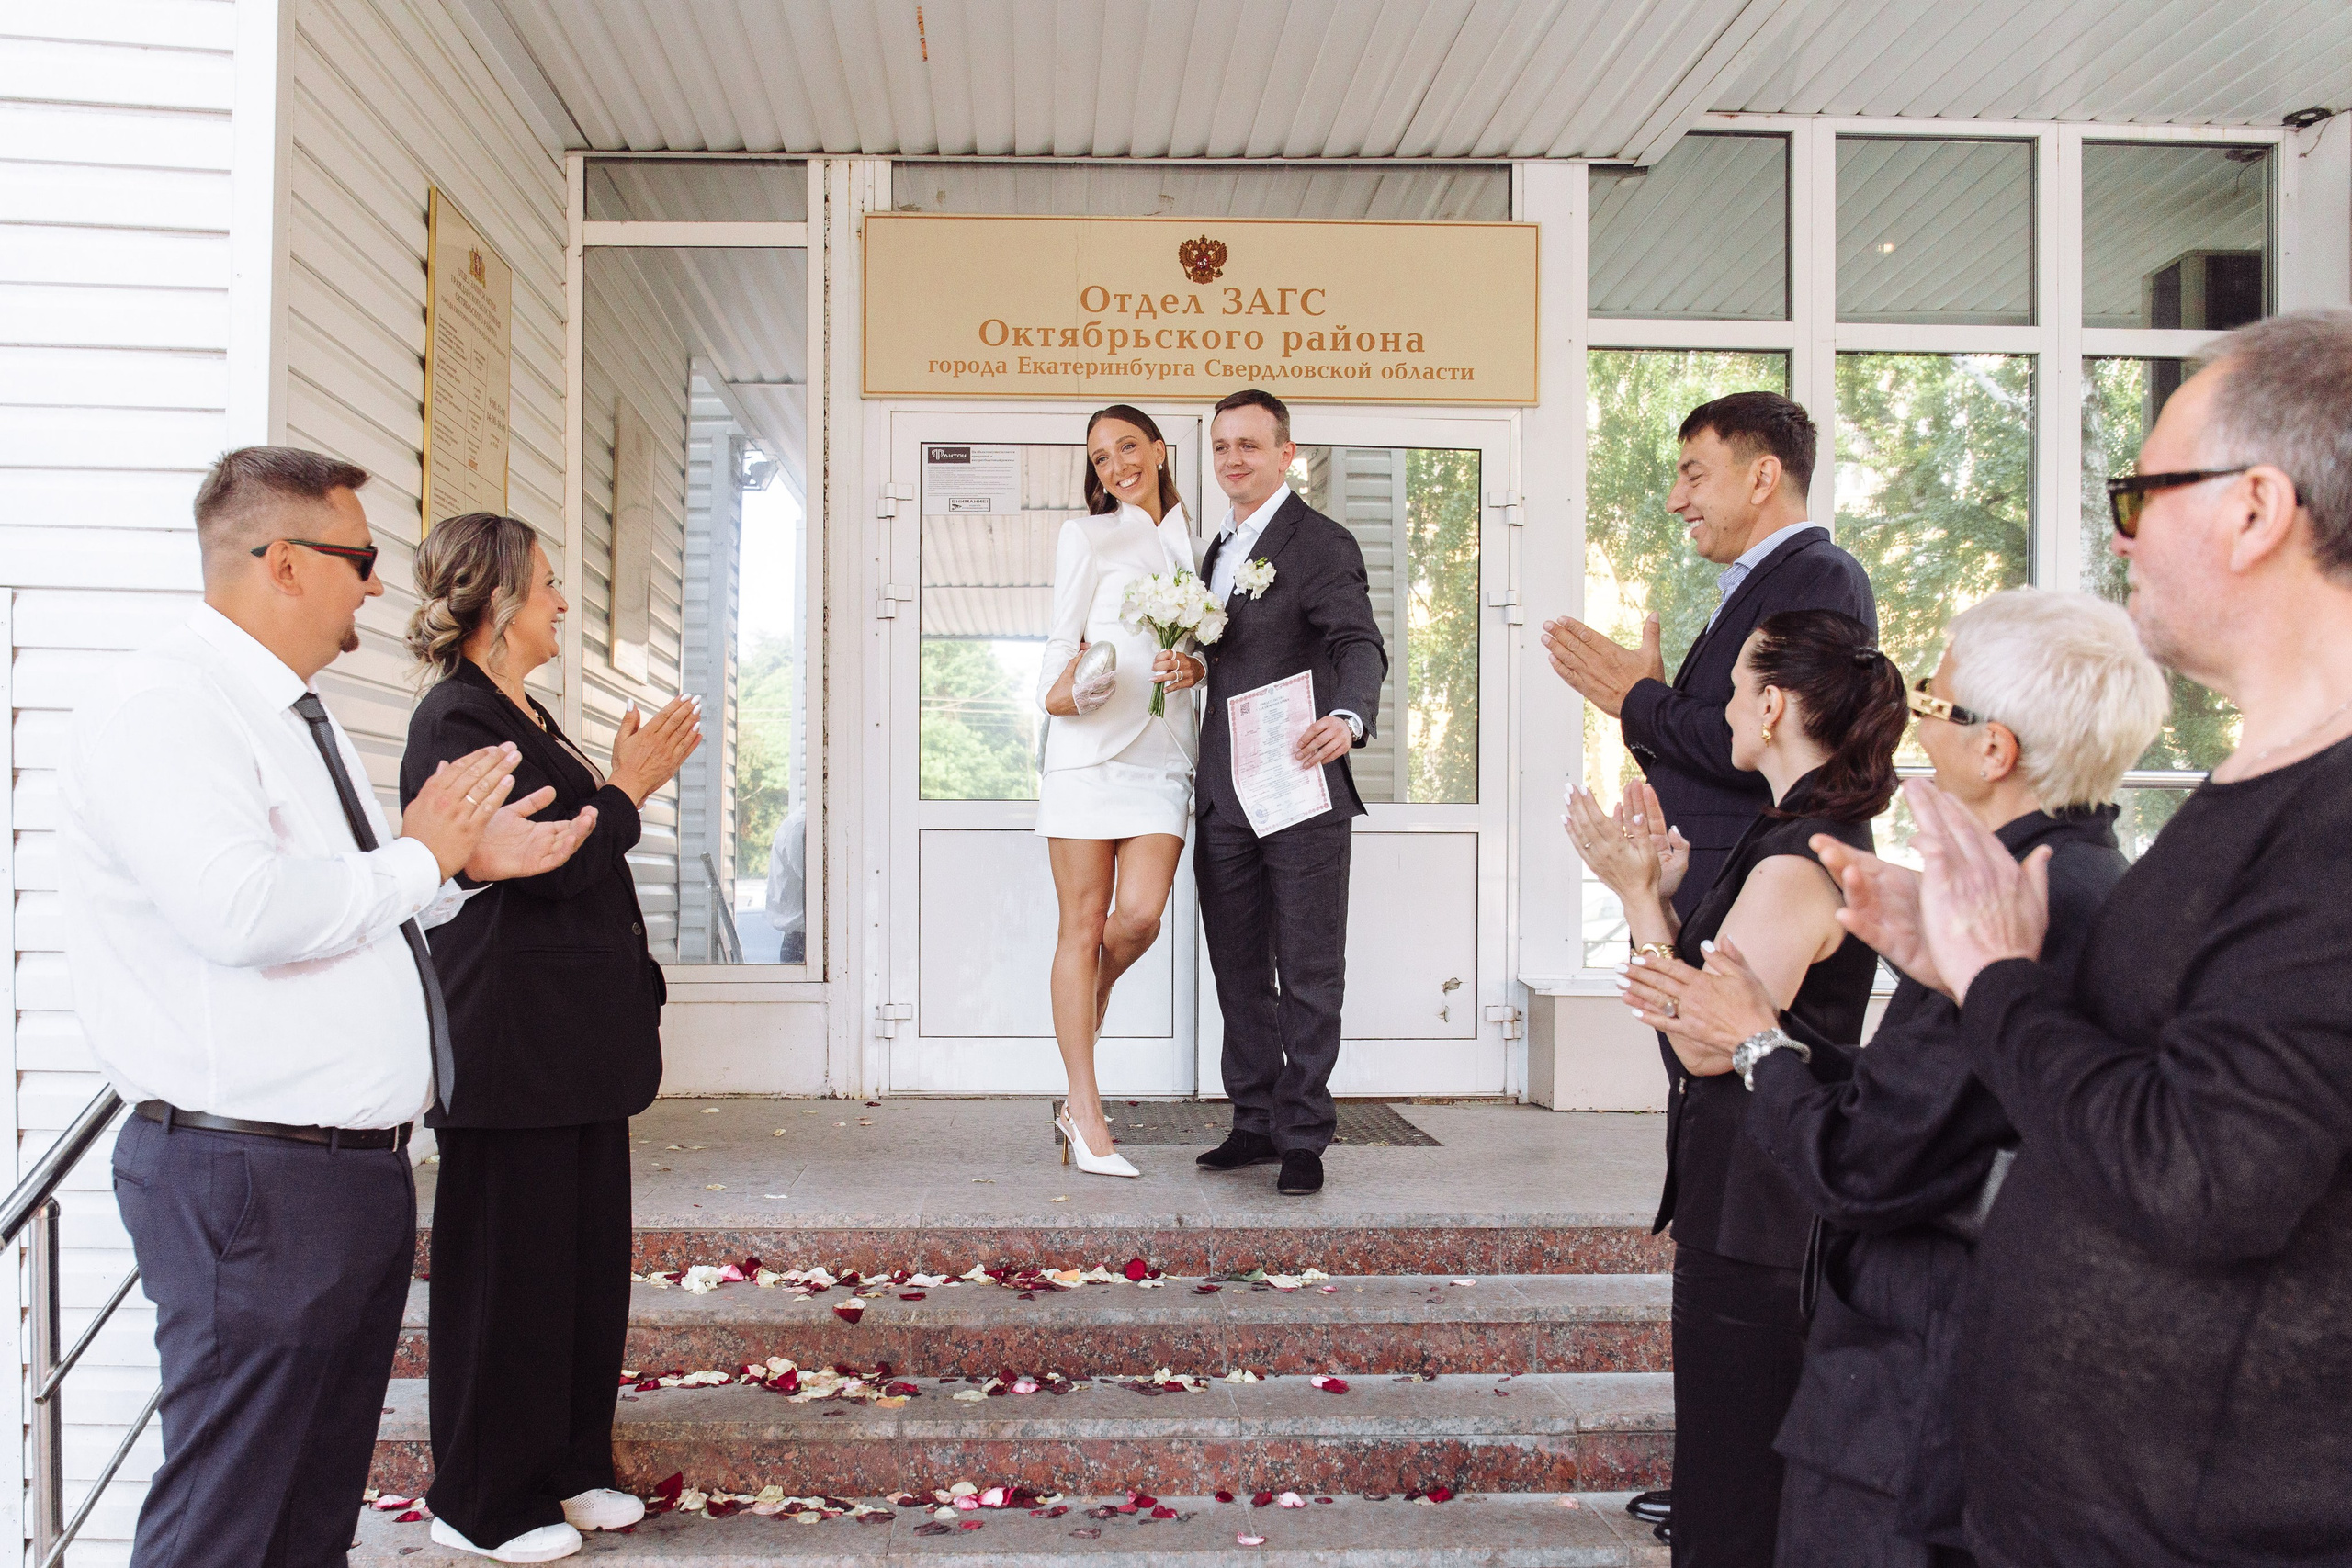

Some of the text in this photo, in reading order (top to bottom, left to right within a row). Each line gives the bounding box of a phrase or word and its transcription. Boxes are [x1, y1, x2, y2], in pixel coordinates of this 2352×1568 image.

[1080, 286, 1325, 319] Отдел ЗАГС
[979, 319, 1426, 357] Октябрьского района
[929, 356, 1475, 381] города Екатеринбурга Свердловской области
